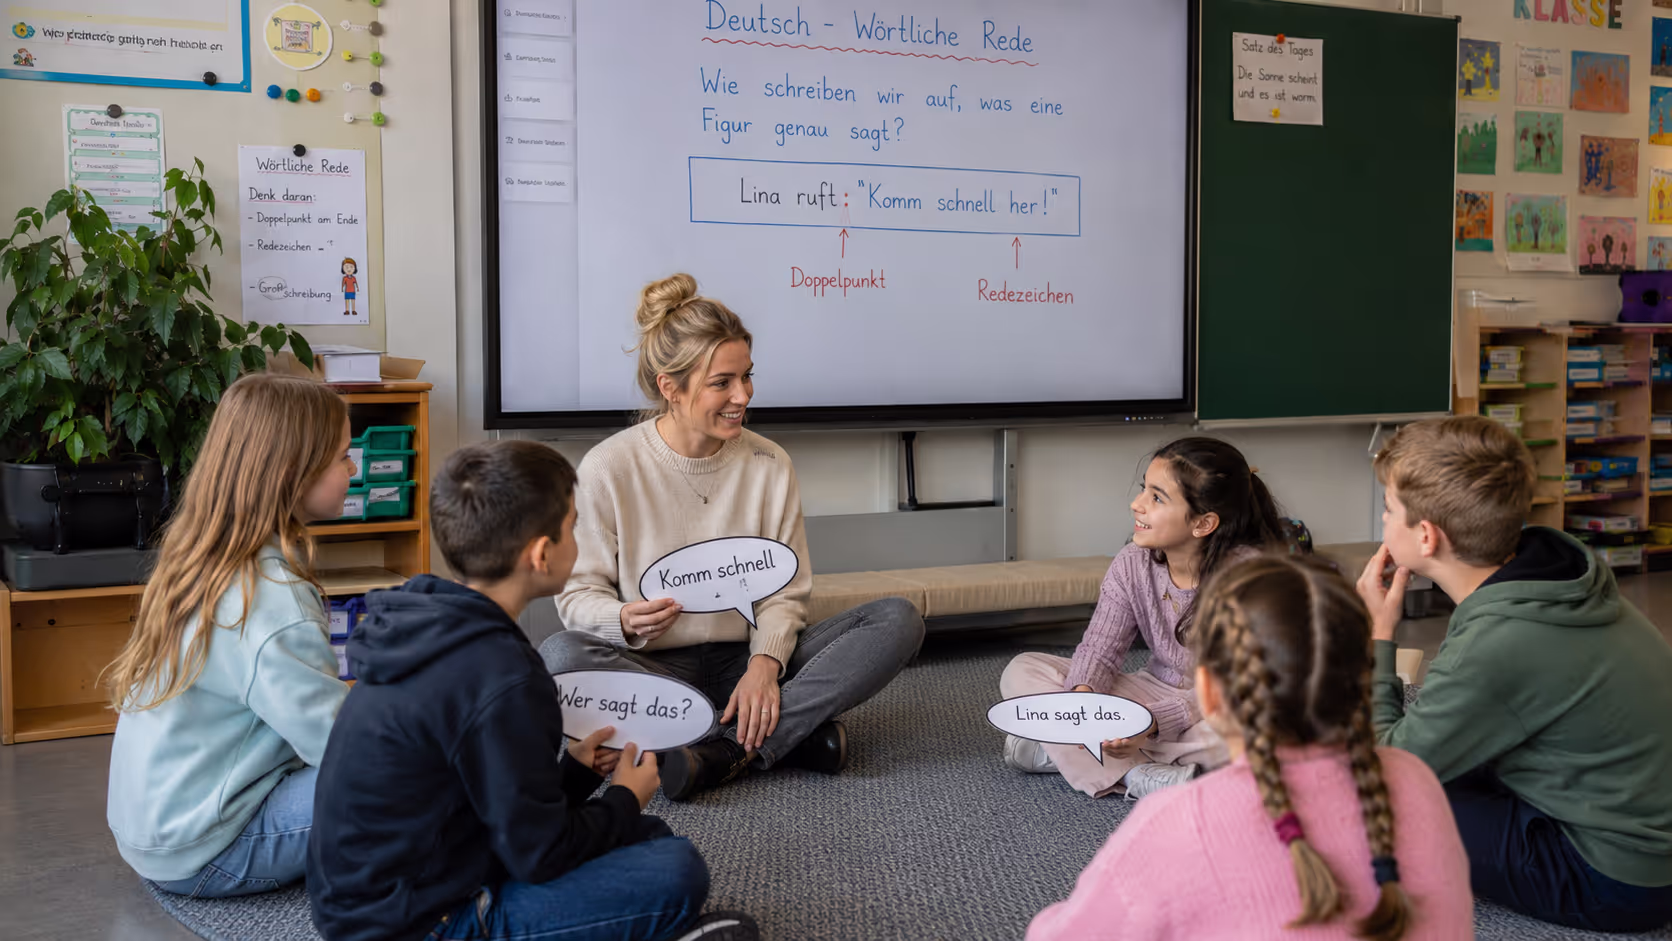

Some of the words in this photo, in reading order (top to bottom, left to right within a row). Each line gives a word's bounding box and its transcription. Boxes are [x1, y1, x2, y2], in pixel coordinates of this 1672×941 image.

[705, 0, 811, 37] Deutsch
[854, 10, 960, 47] Wörtliche
[982, 20, 1034, 53] Rede
[1513, 0, 1623, 29] KLASSE
[1267, 40, 1284, 54] des
[1237, 65, 1253, 80] Die
[1288, 71, 1319, 86] scheint
[700, 66, 740, 95] Wie
[764, 73, 856, 102] schreiben
[877, 88, 904, 105] wir
[926, 85, 962, 112] auf,
[980, 95, 1013, 113] was
[1030, 97, 1064, 116] eine
[1238, 86, 1255, 99] und
[1259, 90, 1270, 100] es
[1274, 88, 1287, 102] ist
[702, 107, 752, 144] Figur
[774, 120, 829, 146] genau
[850, 117, 904, 151] sagt?
[256, 157, 314, 173] Wörtliche
[321, 159, 350, 174] Rede
[249, 187, 276, 201] Denk
[282, 188, 317, 202] daran:
[740, 178, 781, 205] Lina
[937, 188, 996, 213] schnell
[257, 212, 312, 227] Doppelpunkt
[337, 213, 359, 225] Ende
[258, 239, 312, 251] Redezeichen
[790, 266, 886, 298] Doppelpunkt
[977, 278, 1074, 304] Redezeichen
[658, 568, 713, 590] Komm
[717, 549, 777, 579] schnell
[557, 684, 593, 709] Wer
[598, 694, 638, 720] sagt
[645, 696, 693, 721] das?
[1015, 705, 1049, 721] Lina
[1054, 705, 1088, 726] sagt
[1093, 705, 1126, 721] das.
